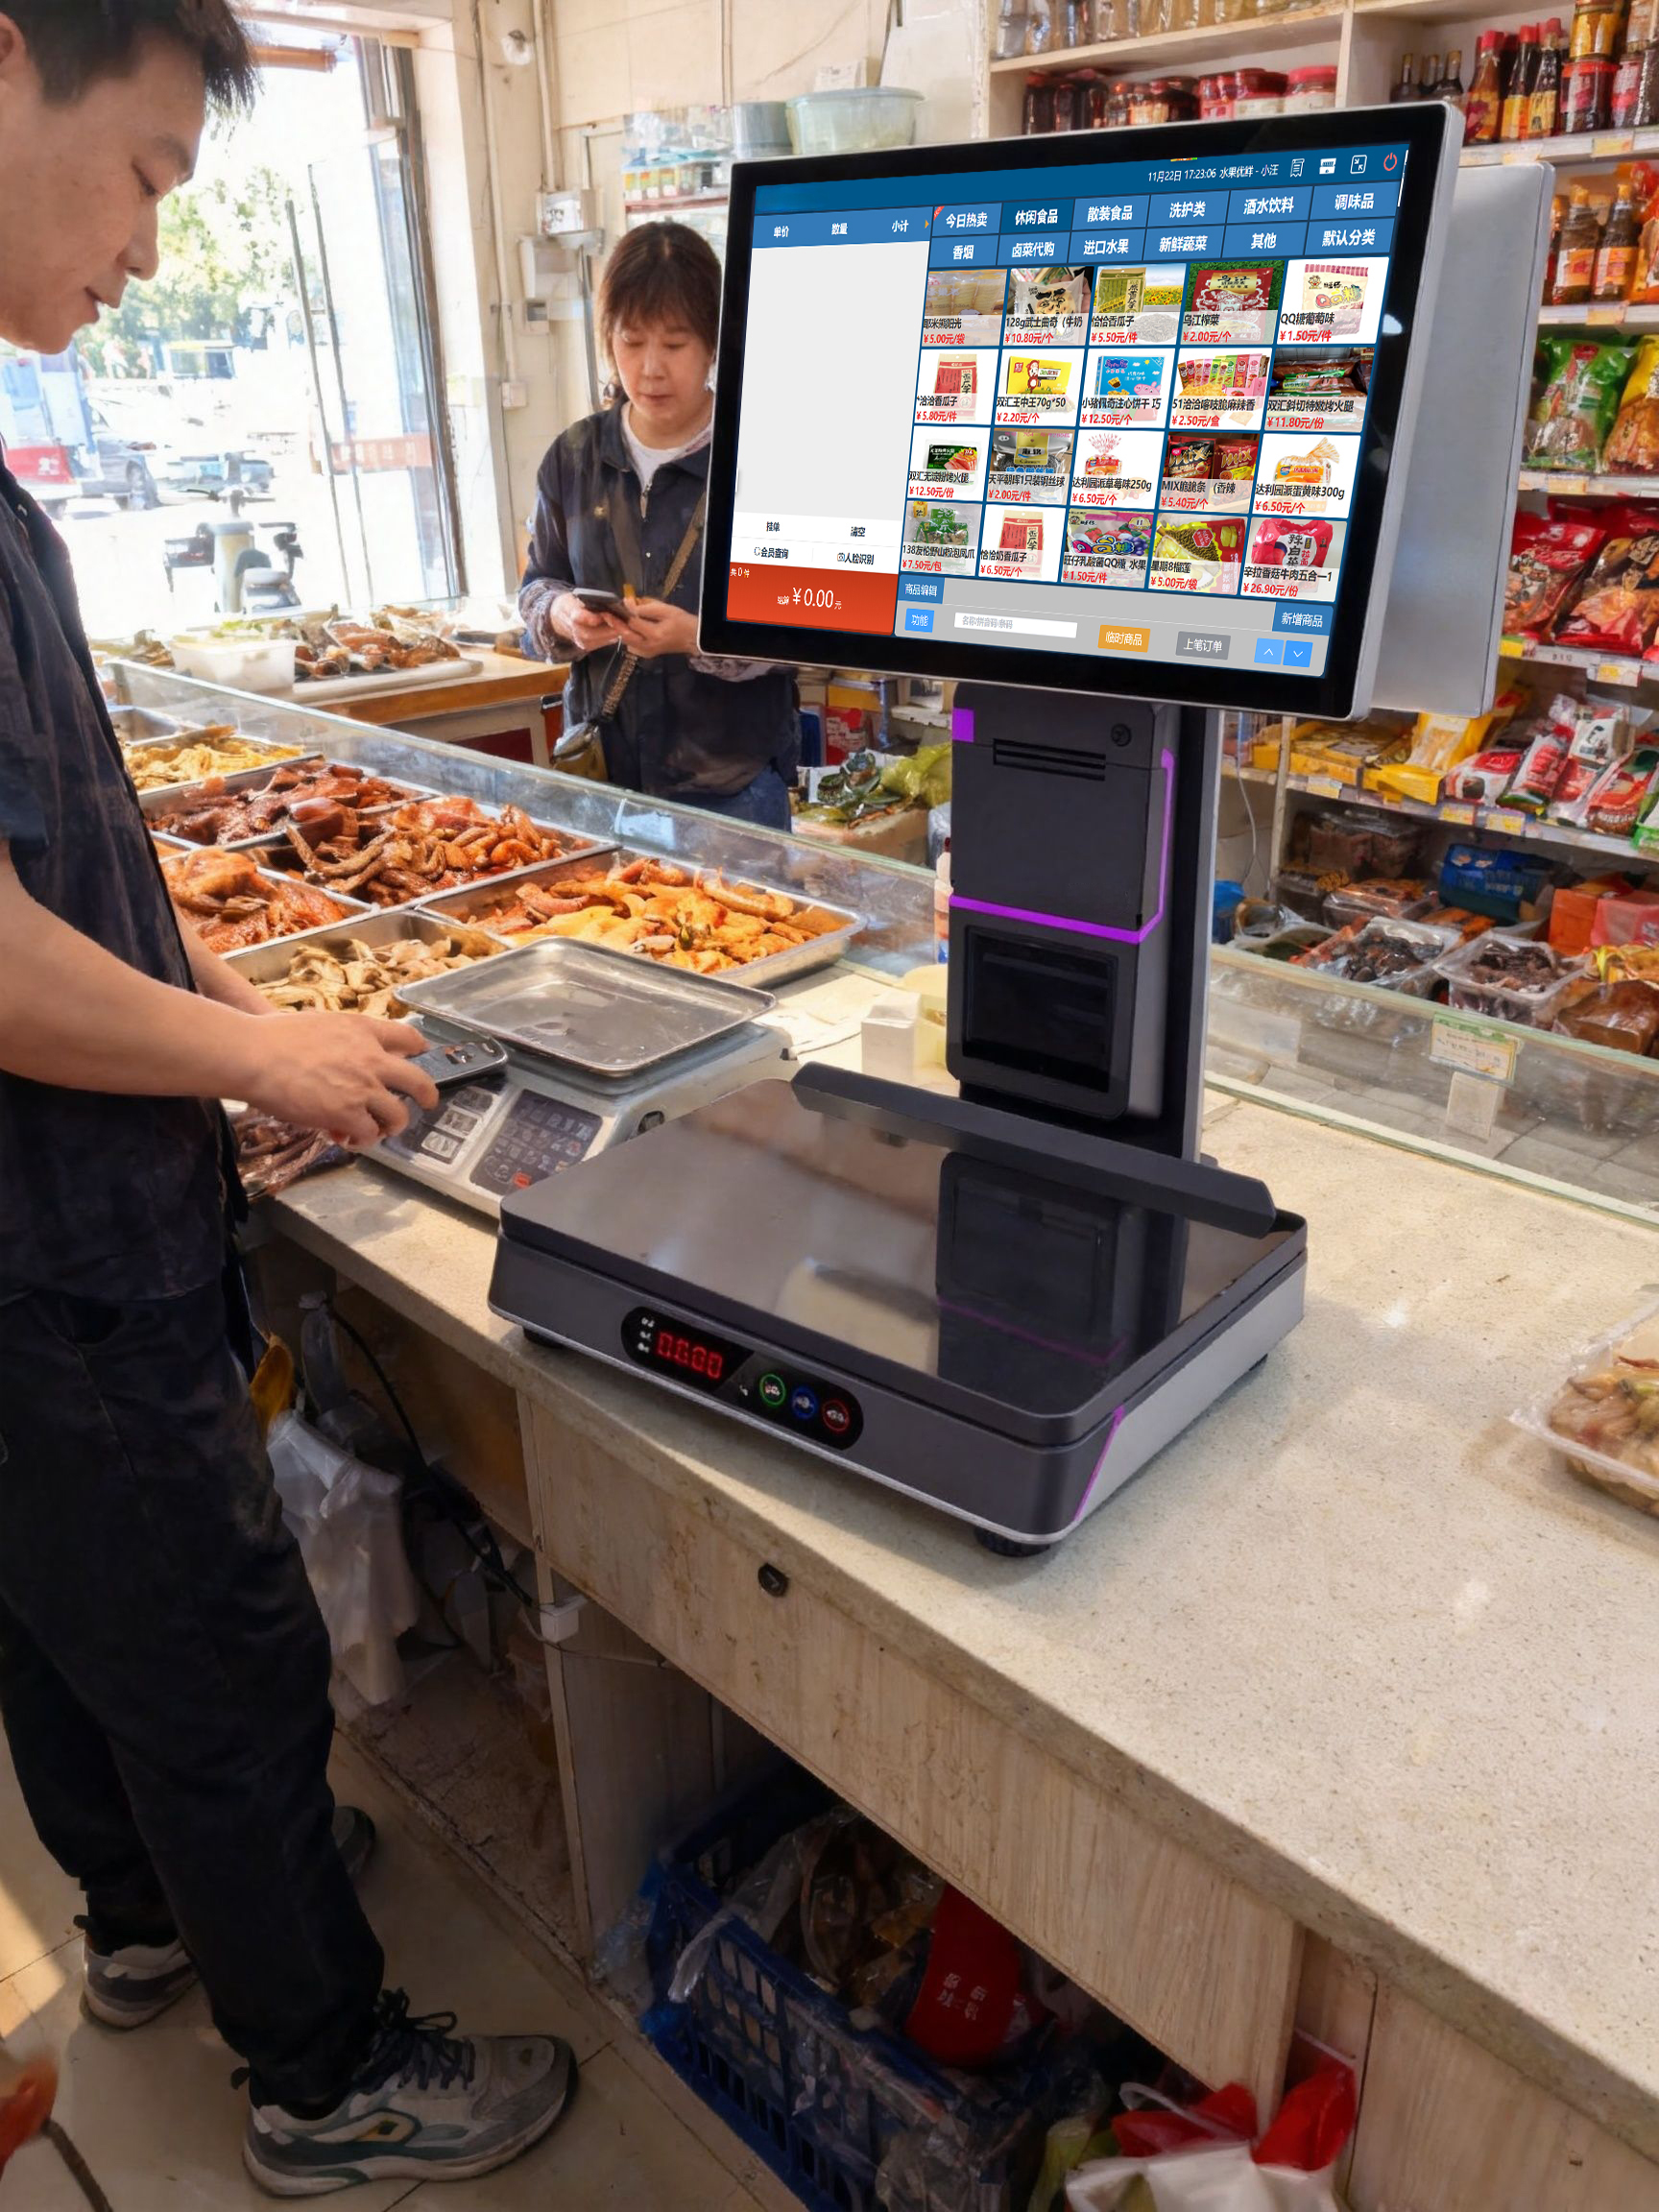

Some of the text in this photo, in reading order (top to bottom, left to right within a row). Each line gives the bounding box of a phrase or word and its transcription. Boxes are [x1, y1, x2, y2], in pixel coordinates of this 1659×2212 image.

[1147, 170, 1182, 182] 11月22日
[1184, 168, 1216, 180] 17:23:06
[1261, 163, 1279, 177] 小汪
[1169, 201, 1206, 218] 洗护类
[1243, 196, 1294, 215] 酒水饮料
[1334, 193, 1375, 210] 调味品
[946, 211, 988, 228] 今日热卖
[1015, 208, 1058, 226] 休闲食品
[1087, 205, 1133, 223] 散装食品
[774, 226, 789, 238] 单价
[831, 223, 848, 235] 数量
[892, 220, 909, 232] 小计
[1159, 235, 1208, 252] 新鲜蔬菜
[1251, 232, 1276, 250] 其他
[1322, 228, 1376, 247] 默认分类
[952, 245, 974, 260] 香烟
[1012, 241, 1055, 258] 卤菜代购
[1083, 238, 1129, 255] 进口水果
[1183, 314, 1220, 326] 乌江榨菜
[1280, 312, 1334, 325] QQ糖葡萄味
[1071, 476, 1152, 492] 达利园派草莓味250g
[1255, 483, 1345, 500] 达利园派蛋黄味300g
[766, 521, 781, 532] 挂单
[851, 526, 866, 537] 清空
[760, 547, 789, 559] 会员查询
[844, 553, 875, 565] 人脸识别
[1150, 560, 1192, 574] 星期8榴莲
[904, 583, 938, 596] 商品编辑
[911, 613, 928, 627] 功能
[1281, 612, 1323, 628] 新增商品
[1105, 631, 1142, 646] 临时商品
[1183, 637, 1223, 653] 上笔订单
